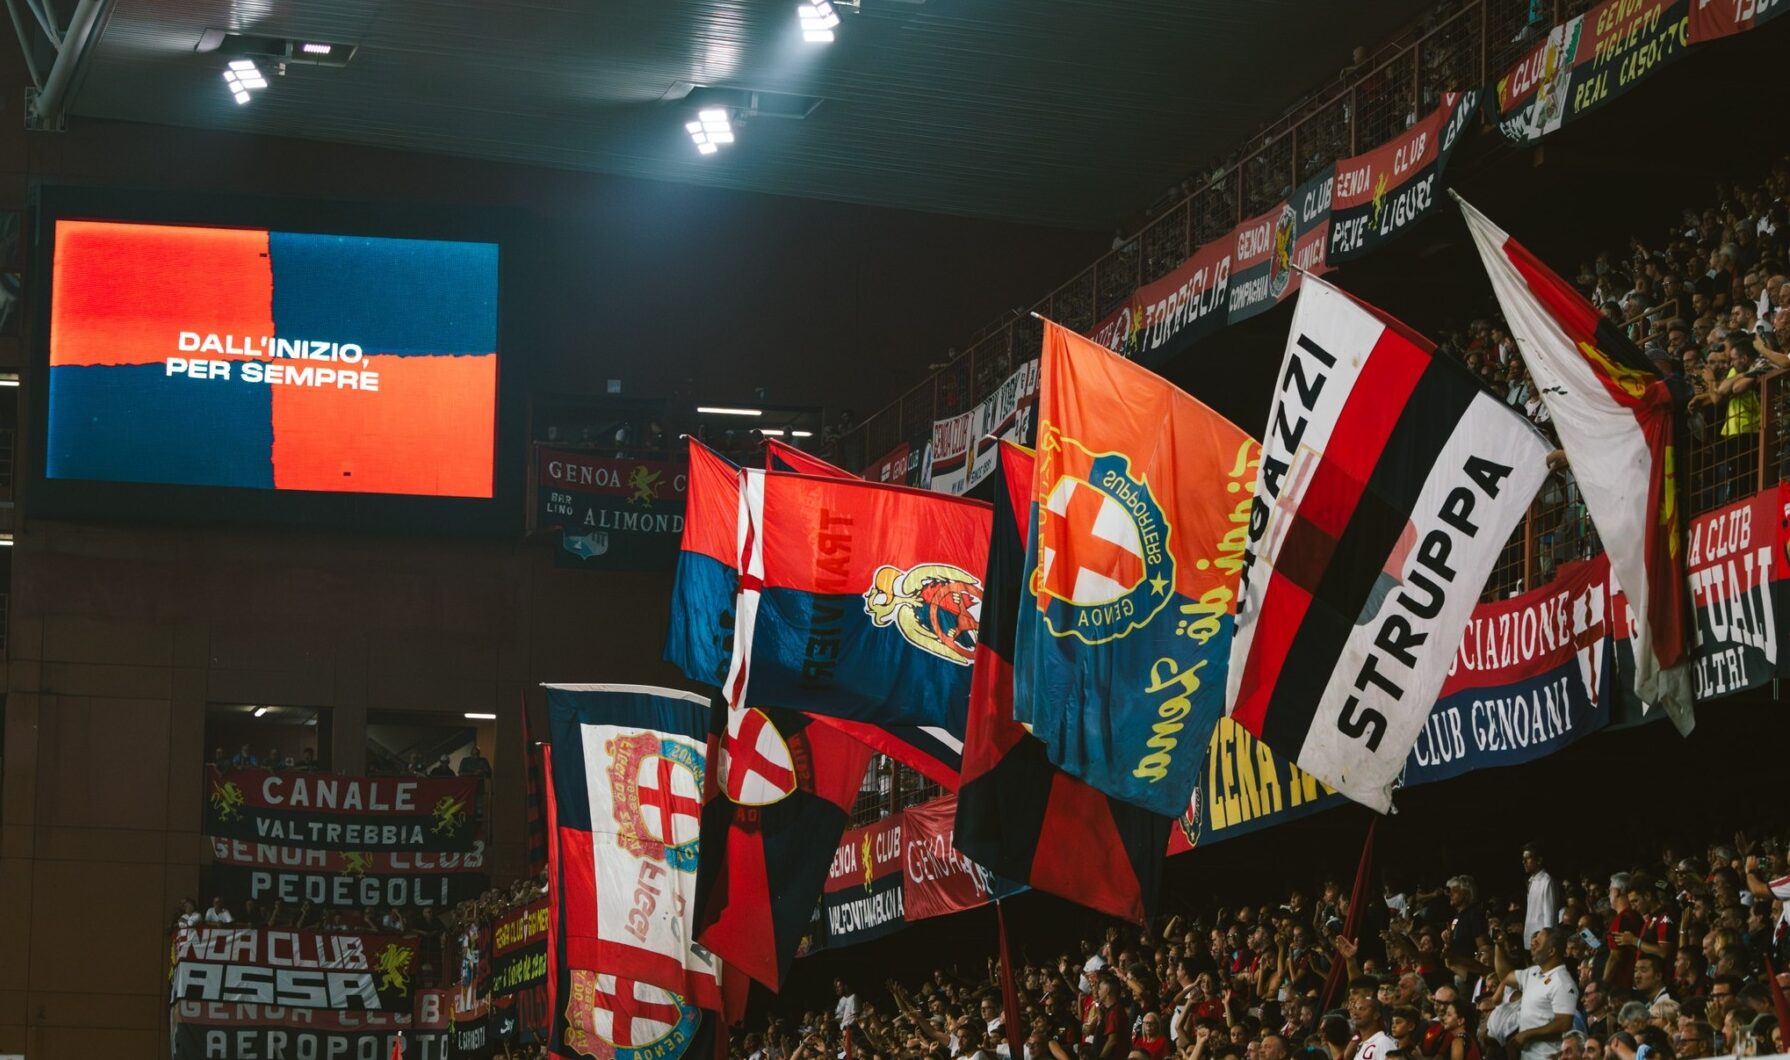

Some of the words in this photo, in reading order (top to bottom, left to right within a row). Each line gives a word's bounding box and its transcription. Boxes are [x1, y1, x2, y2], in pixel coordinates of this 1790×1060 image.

[1594, 3, 1662, 69] TIGLIETO
[1573, 70, 1608, 114] REAL
[1619, 16, 1689, 87] CASOTTO
[1337, 165, 1371, 198] GENOA
[1394, 132, 1427, 176] CLUB
[1237, 221, 1271, 262] GENOA
[1303, 177, 1334, 223] CLUB
[1331, 214, 1368, 254] PIEVE
[1380, 173, 1435, 236] LIGURE
[1142, 255, 1231, 352] TORRIGLIA
[1228, 274, 1269, 312] COMPAGNIA
[178, 331, 370, 369] DALL'INIZIO,
[166, 356, 231, 381] PER
[241, 361, 380, 392] SEMPRE
[549, 461, 621, 488] GENOA
[546, 503, 573, 516] LINO
[551, 492, 572, 504] BAR
[1705, 504, 1752, 562] CLUB
[1337, 455, 1514, 753] STRUPPA
[1414, 706, 1466, 767] CLUB
[1471, 676, 1573, 752] GENOANI
[262, 776, 418, 811] CANALE
[1208, 716, 1283, 831] ZENA
[255, 817, 424, 845] VALTREBBIA
[876, 825, 901, 864] CLUB
[252, 872, 449, 906] PEDEGOLI
[267, 930, 369, 970] CLUB
